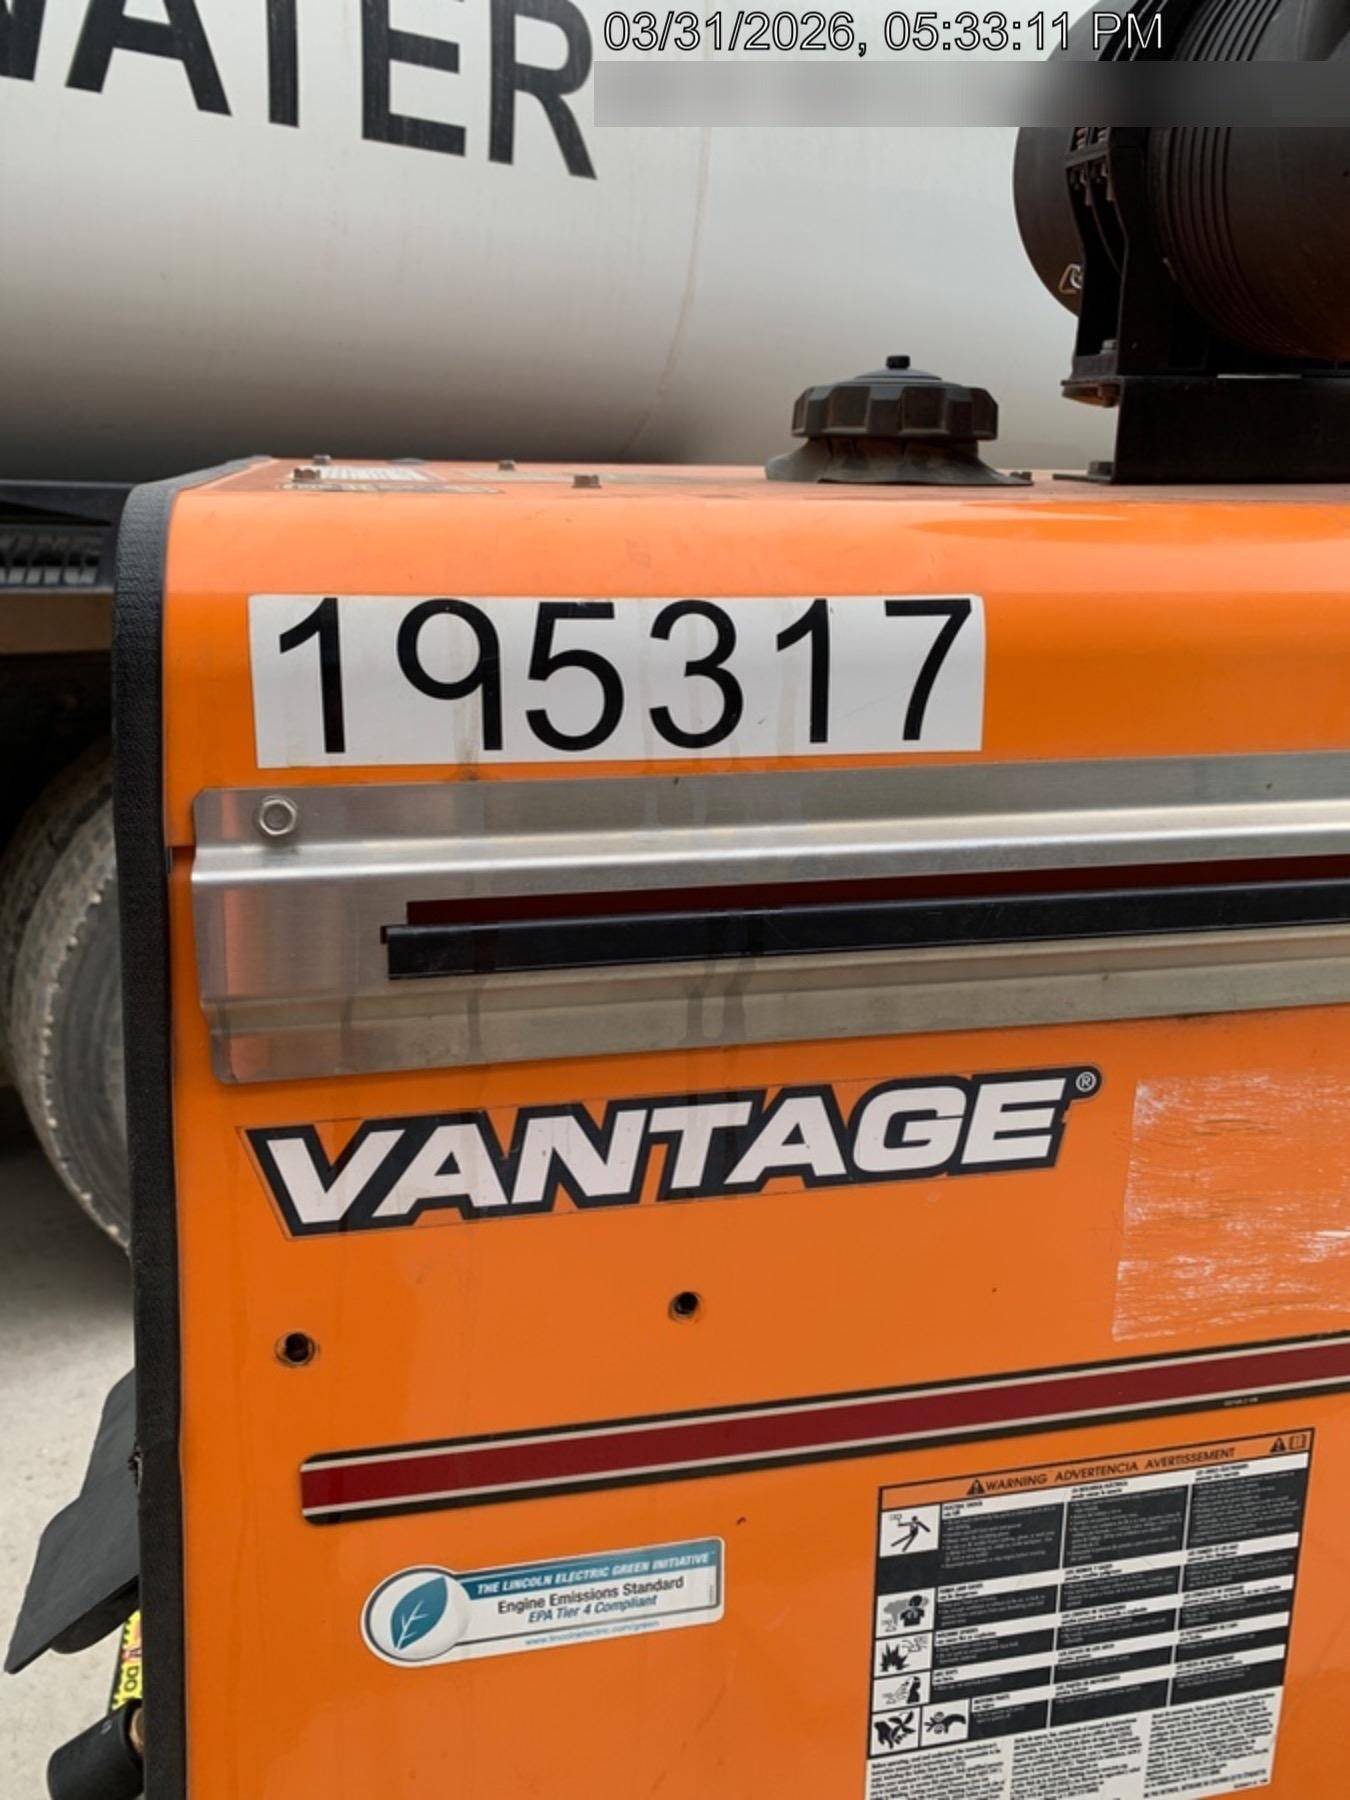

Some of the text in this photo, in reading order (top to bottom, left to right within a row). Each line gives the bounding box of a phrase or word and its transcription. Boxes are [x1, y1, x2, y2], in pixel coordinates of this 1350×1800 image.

[0, 0, 598, 180] AER
[278, 597, 972, 754] 195317
[986, 1473, 1048, 1491] WARNING
[1055, 1462, 1138, 1482] ADVERTENCIA
[1145, 1448, 1236, 1469] AVERTISSEMENT
[477, 1581, 500, 1595] THE
[502, 1574, 553, 1592] LINCOLN
[555, 1566, 609, 1584] ELECTRIC
[611, 1561, 650, 1577] GREEN
[498, 1576, 684, 1615] Engine Emissions Standard
[528, 1595, 658, 1623] EPA Tier 4 Compliant
